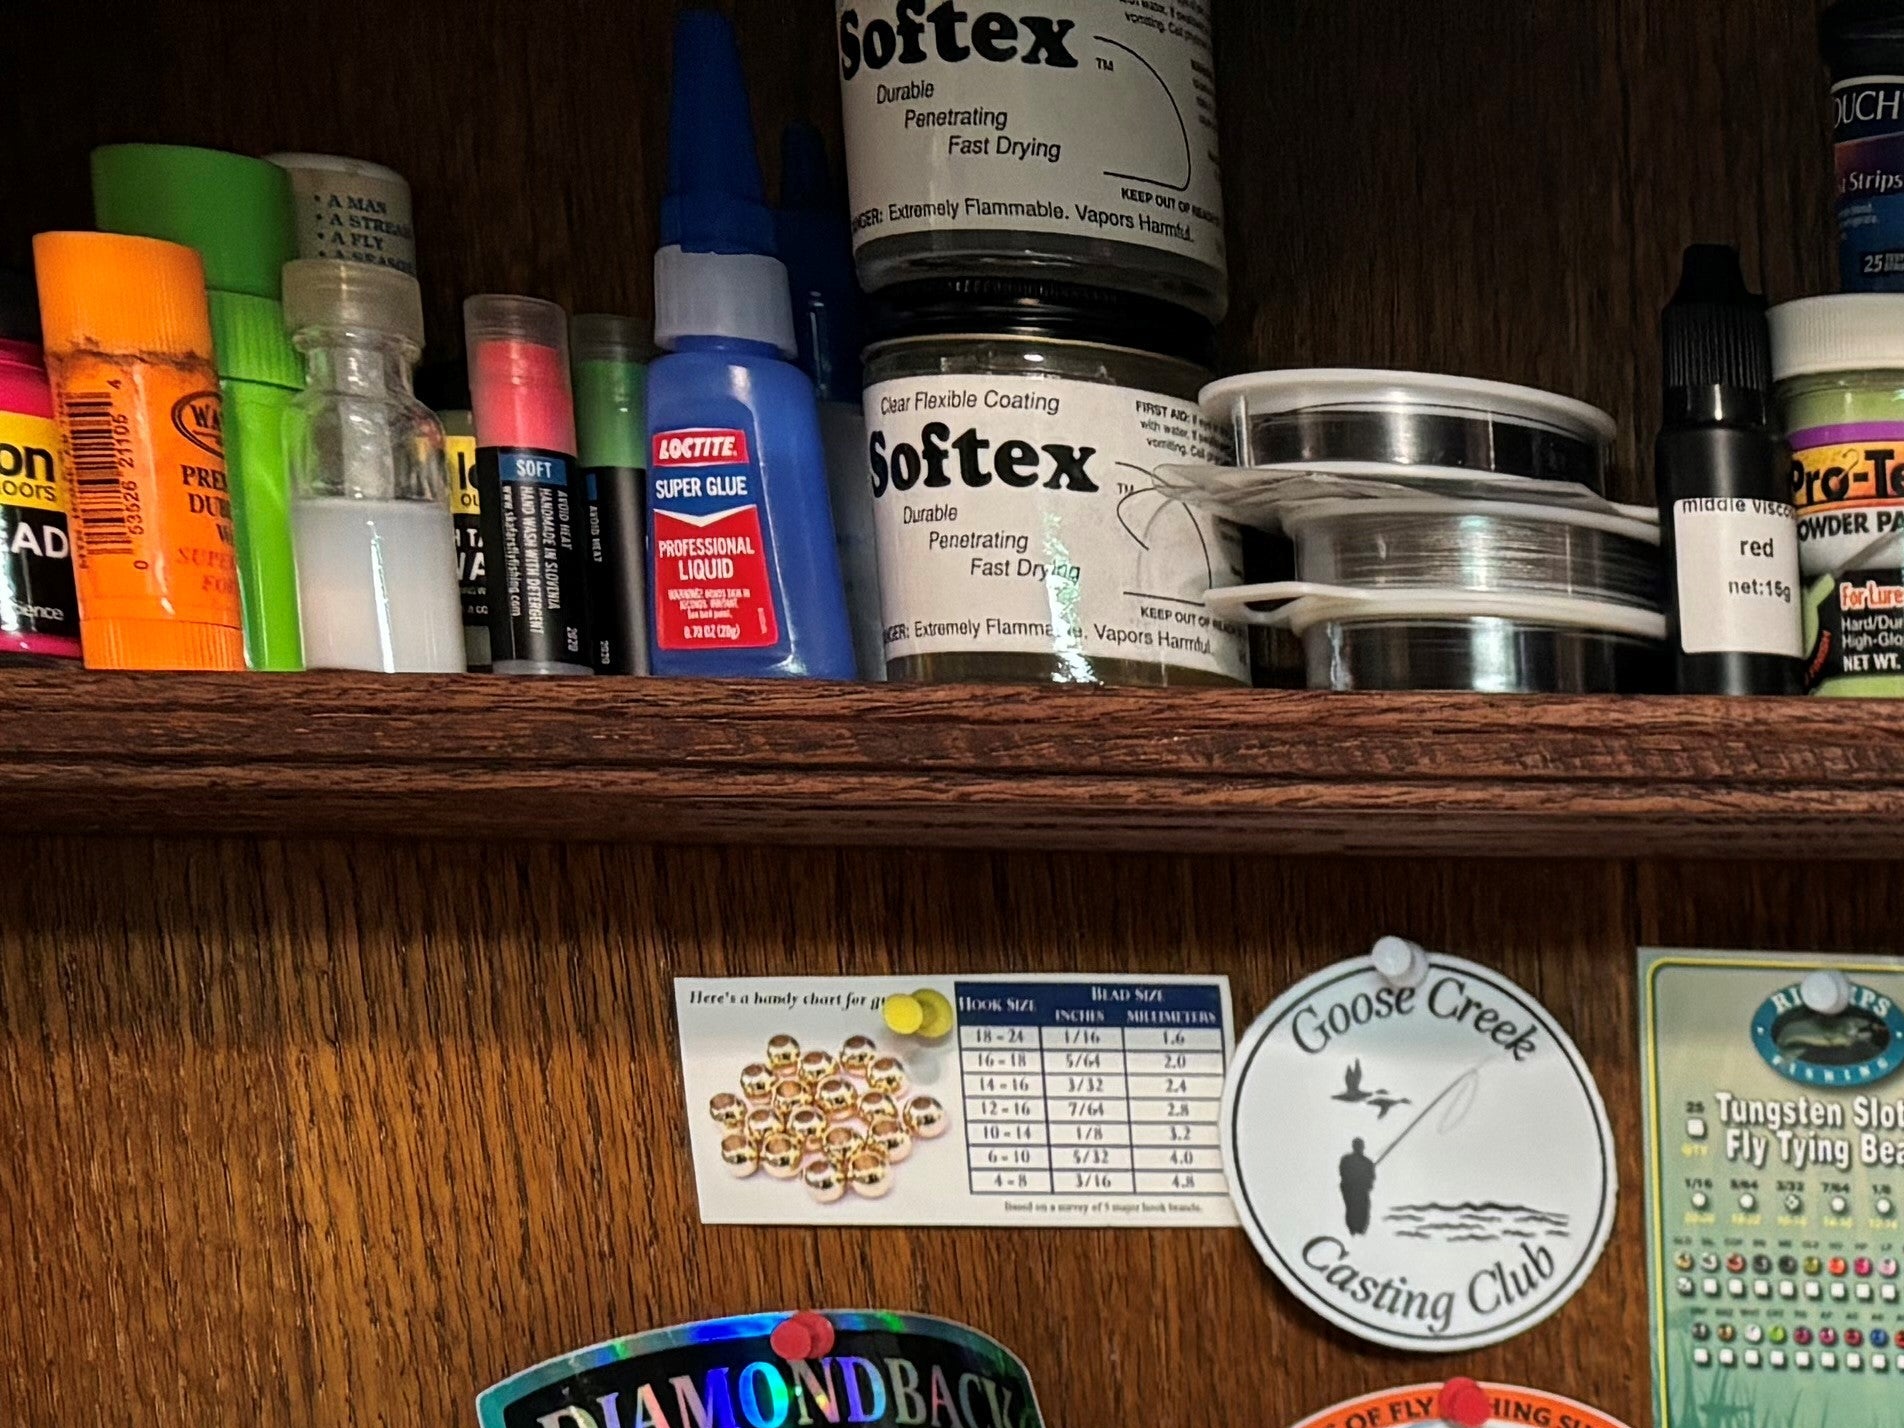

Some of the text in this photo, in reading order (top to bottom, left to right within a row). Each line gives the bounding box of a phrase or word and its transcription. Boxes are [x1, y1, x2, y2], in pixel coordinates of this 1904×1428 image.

[840, 0, 1078, 80] Softex
[876, 80, 935, 105] Durable
[904, 106, 1008, 131] Penetrating
[948, 136, 1061, 162] Fast Drying
[1850, 171, 1904, 193] Strips
[329, 195, 387, 214] A MAN
[1121, 187, 1153, 205] KEEP
[1156, 195, 1177, 211] OUT
[330, 214, 343, 226] A
[888, 198, 959, 222] Extremely
[964, 196, 1069, 220] Flammable.
[1074, 204, 1135, 230] Vapors
[332, 232, 383, 251] A FLY
[1863, 255, 1883, 273] 25
[880, 388, 1060, 416] Clear Flexible Coating
[1135, 400, 1167, 418] FIRST
[659, 436, 735, 460] LOCTITE
[516, 459, 552, 479] SOFT
[869, 421, 1099, 498] Softex
[656, 476, 747, 499] SUPER GLUE
[539, 488, 556, 545] HANDMADE
[903, 504, 958, 525] Durable
[658, 537, 755, 558] PROFESSIONAL
[929, 531, 1028, 553] Penetrating
[1740, 538, 1774, 558] red
[520, 486, 544, 634] HAND WASH WITH DETERGENT
[678, 559, 734, 581] LIQUID
[970, 557, 1080, 584] Fast Drying
[545, 561, 560, 610] SLOVENIA
[1728, 579, 1791, 603] net:15g
[1140, 606, 1172, 623] KEEP
[1174, 611, 1197, 627] OUT
[914, 618, 981, 639] Extremely
[1094, 623, 1154, 645] Vapors
[1843, 654, 1901, 672] NET WT.
[690, 990, 737, 1004] Here's
[740, 994, 749, 1004] a
[754, 991, 799, 1010] handy
[803, 991, 842, 1006] chart
[842, 991, 866, 1011] for
[959, 996, 1037, 1012] HOOK SIZE
[1092, 987, 1165, 1001] BEAD SIZE
[1055, 1010, 1216, 1023] INCHES MILLIMETERS
[1291, 977, 1538, 1063] Goose Creek
[1162, 1031, 1185, 1044] 1.6
[1164, 1055, 1186, 1069] 2.0
[1165, 1079, 1187, 1093] 2.4
[1167, 1103, 1189, 1117] 2.8
[1714, 1091, 1843, 1131] Tungsten
[1169, 1127, 1191, 1141] 3.2
[1169, 1152, 1193, 1165] 4.0
[1725, 1129, 1767, 1167] Fly
[1776, 1130, 1850, 1170] Tying
[1171, 1175, 1195, 1189] 4.8
[1300, 1235, 1555, 1335] Casting Club
[1390, 1397, 1436, 1424] FLY
